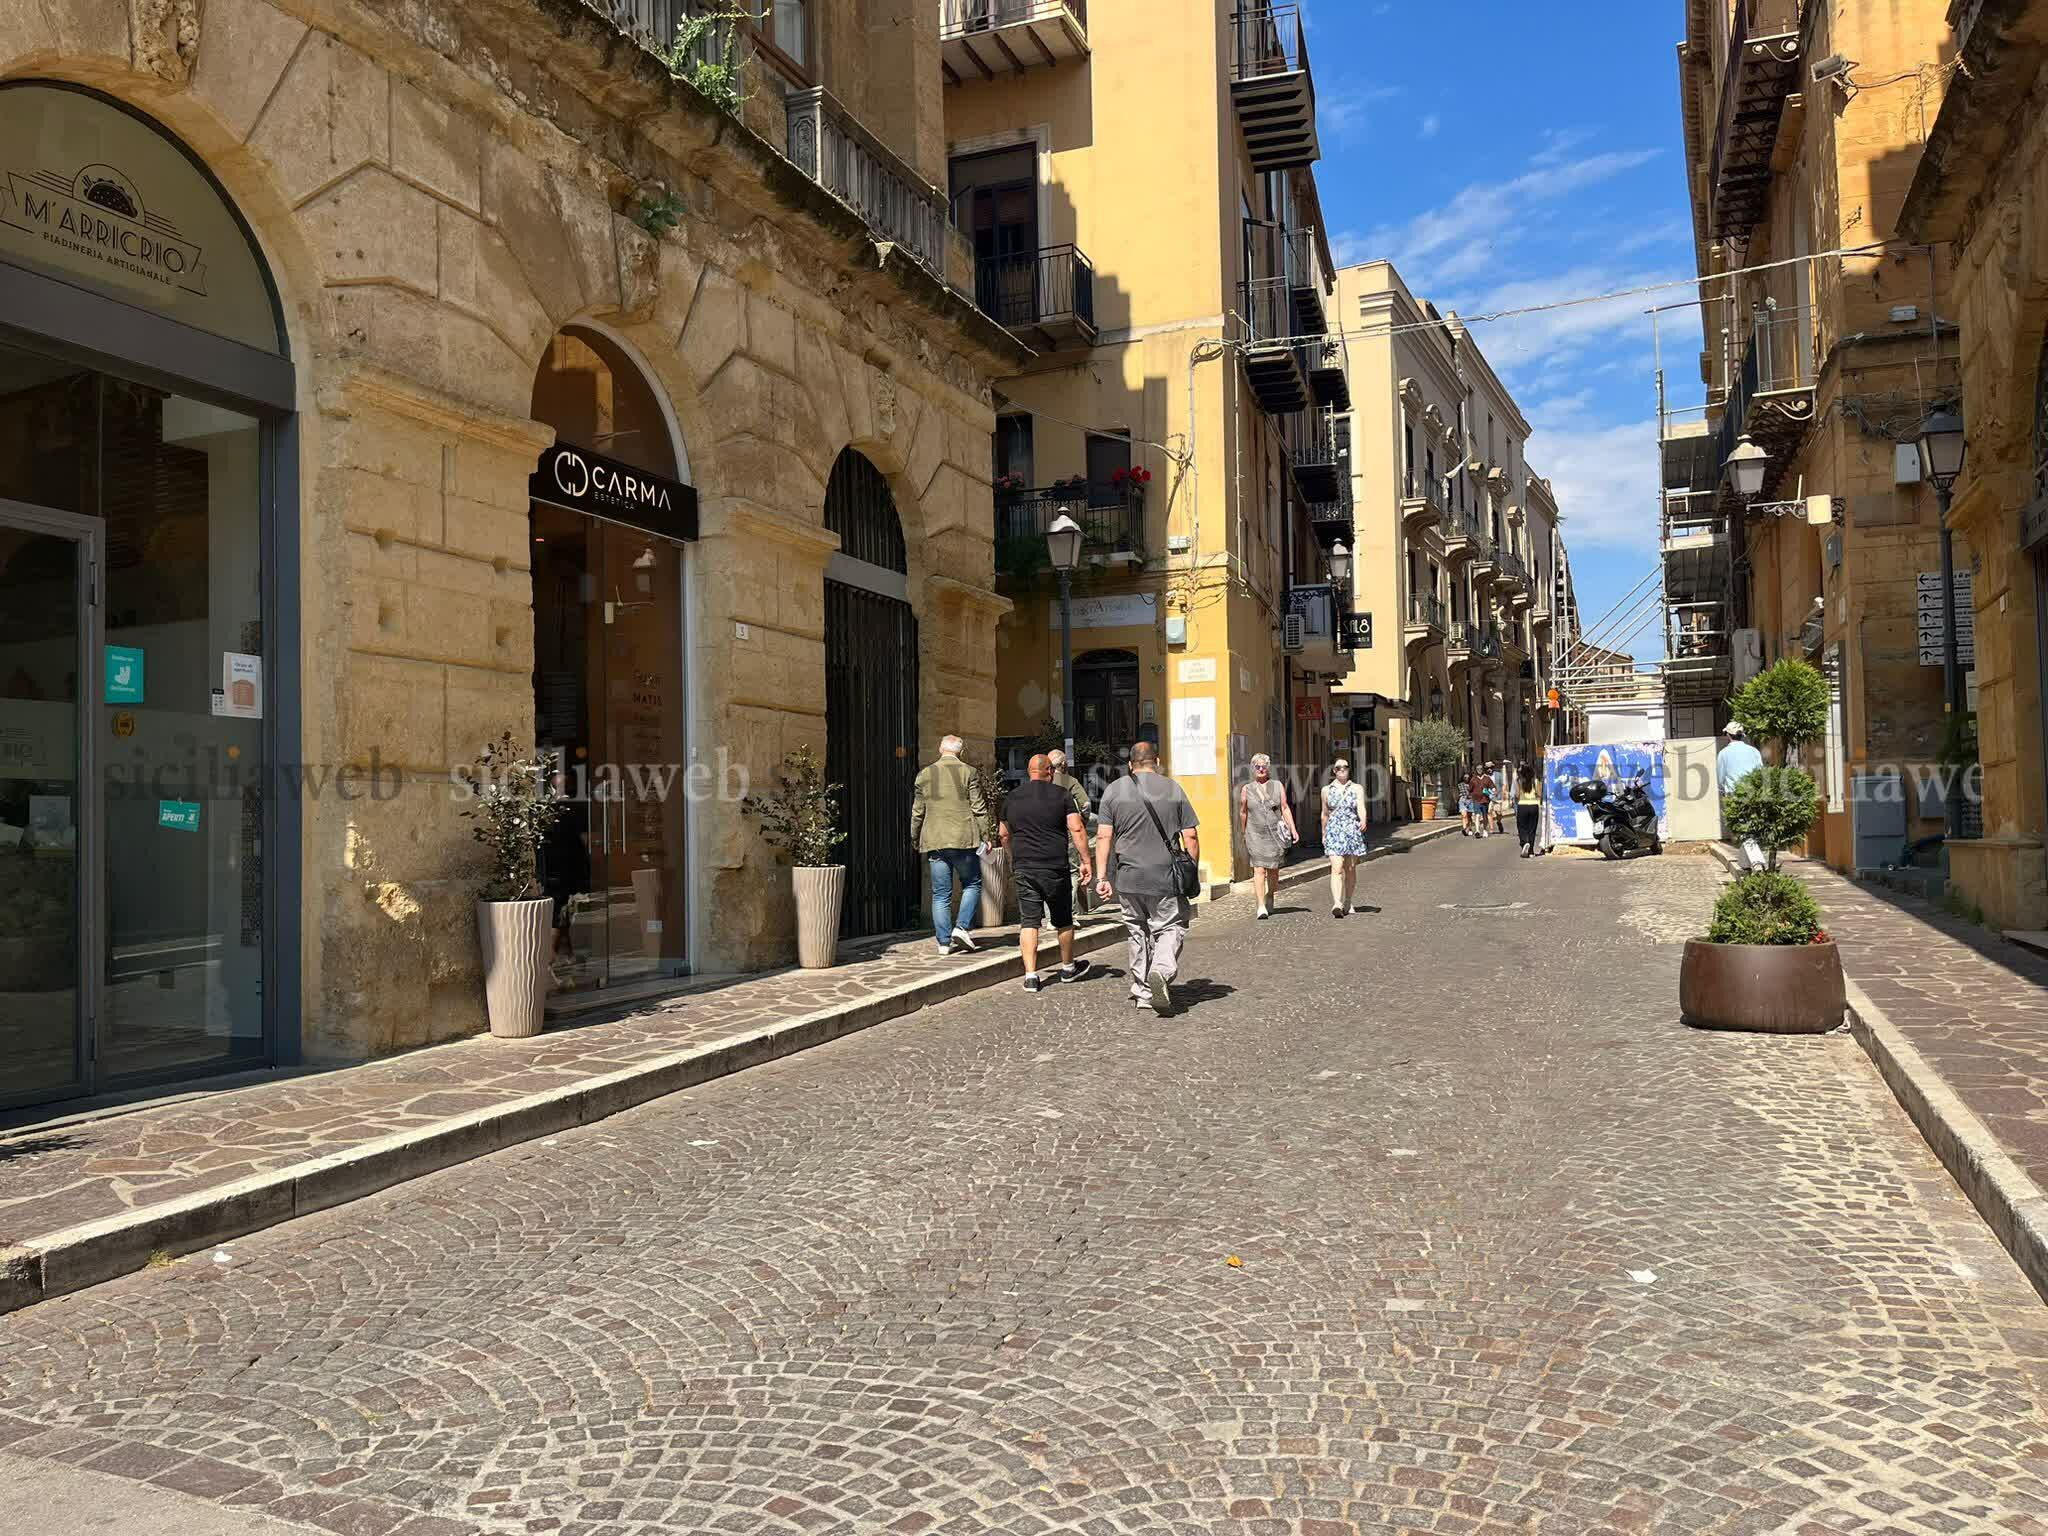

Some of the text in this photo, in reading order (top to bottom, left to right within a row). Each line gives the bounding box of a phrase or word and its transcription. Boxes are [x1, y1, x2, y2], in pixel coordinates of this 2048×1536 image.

[43, 232, 171, 285] PIADINERIA ARTIGIANALE
[592, 466, 672, 511] CARMA
